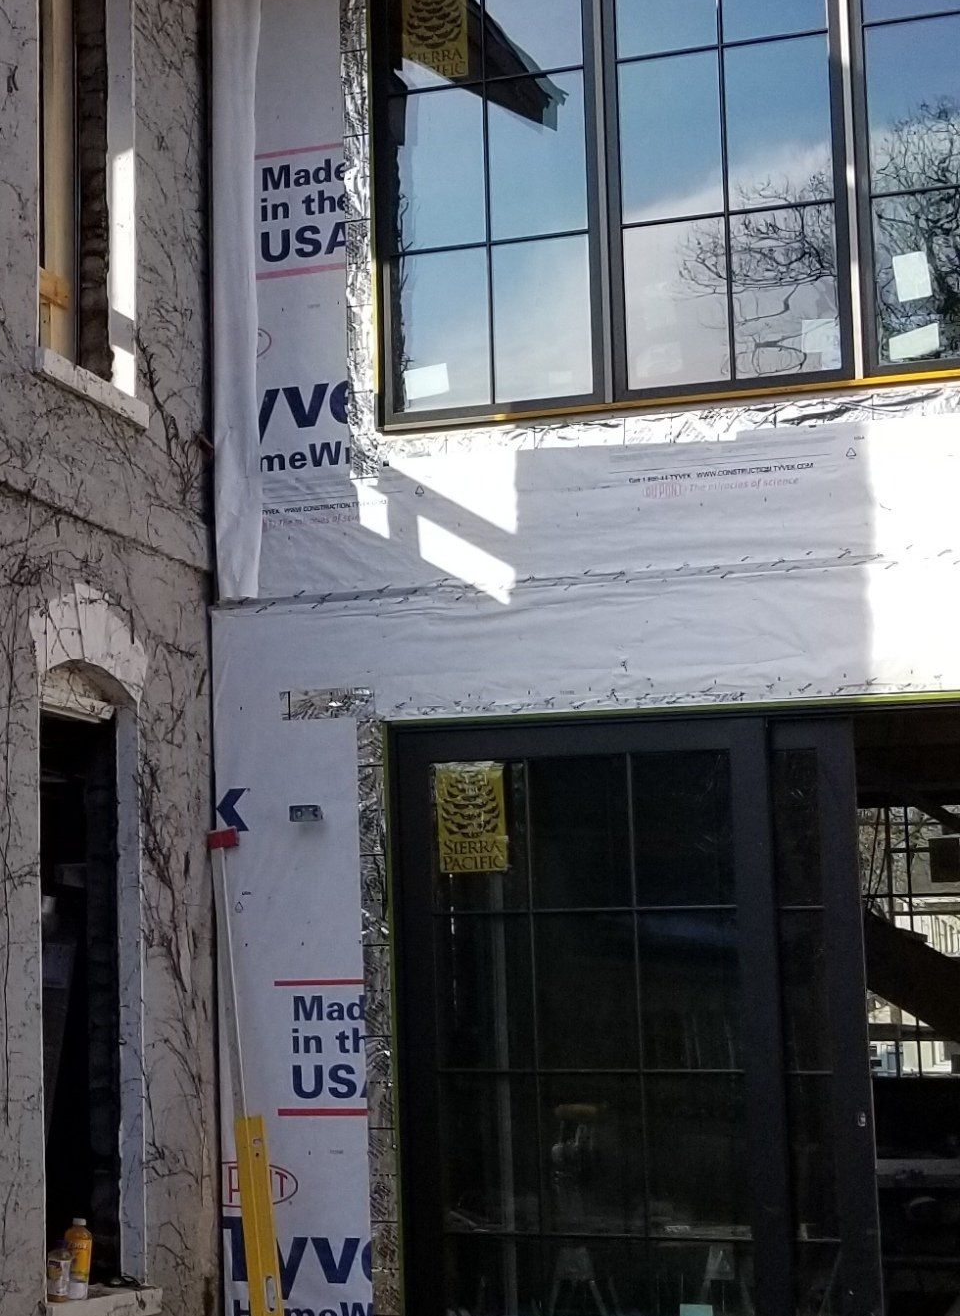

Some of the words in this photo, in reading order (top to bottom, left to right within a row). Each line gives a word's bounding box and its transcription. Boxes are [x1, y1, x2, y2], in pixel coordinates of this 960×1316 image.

[260, 197, 289, 222] in
[260, 221, 346, 263] USA
[444, 840, 503, 855] SIERRA
[443, 855, 505, 871] PACIFIC
[292, 1028, 323, 1054] in
[292, 1064, 368, 1099] US
